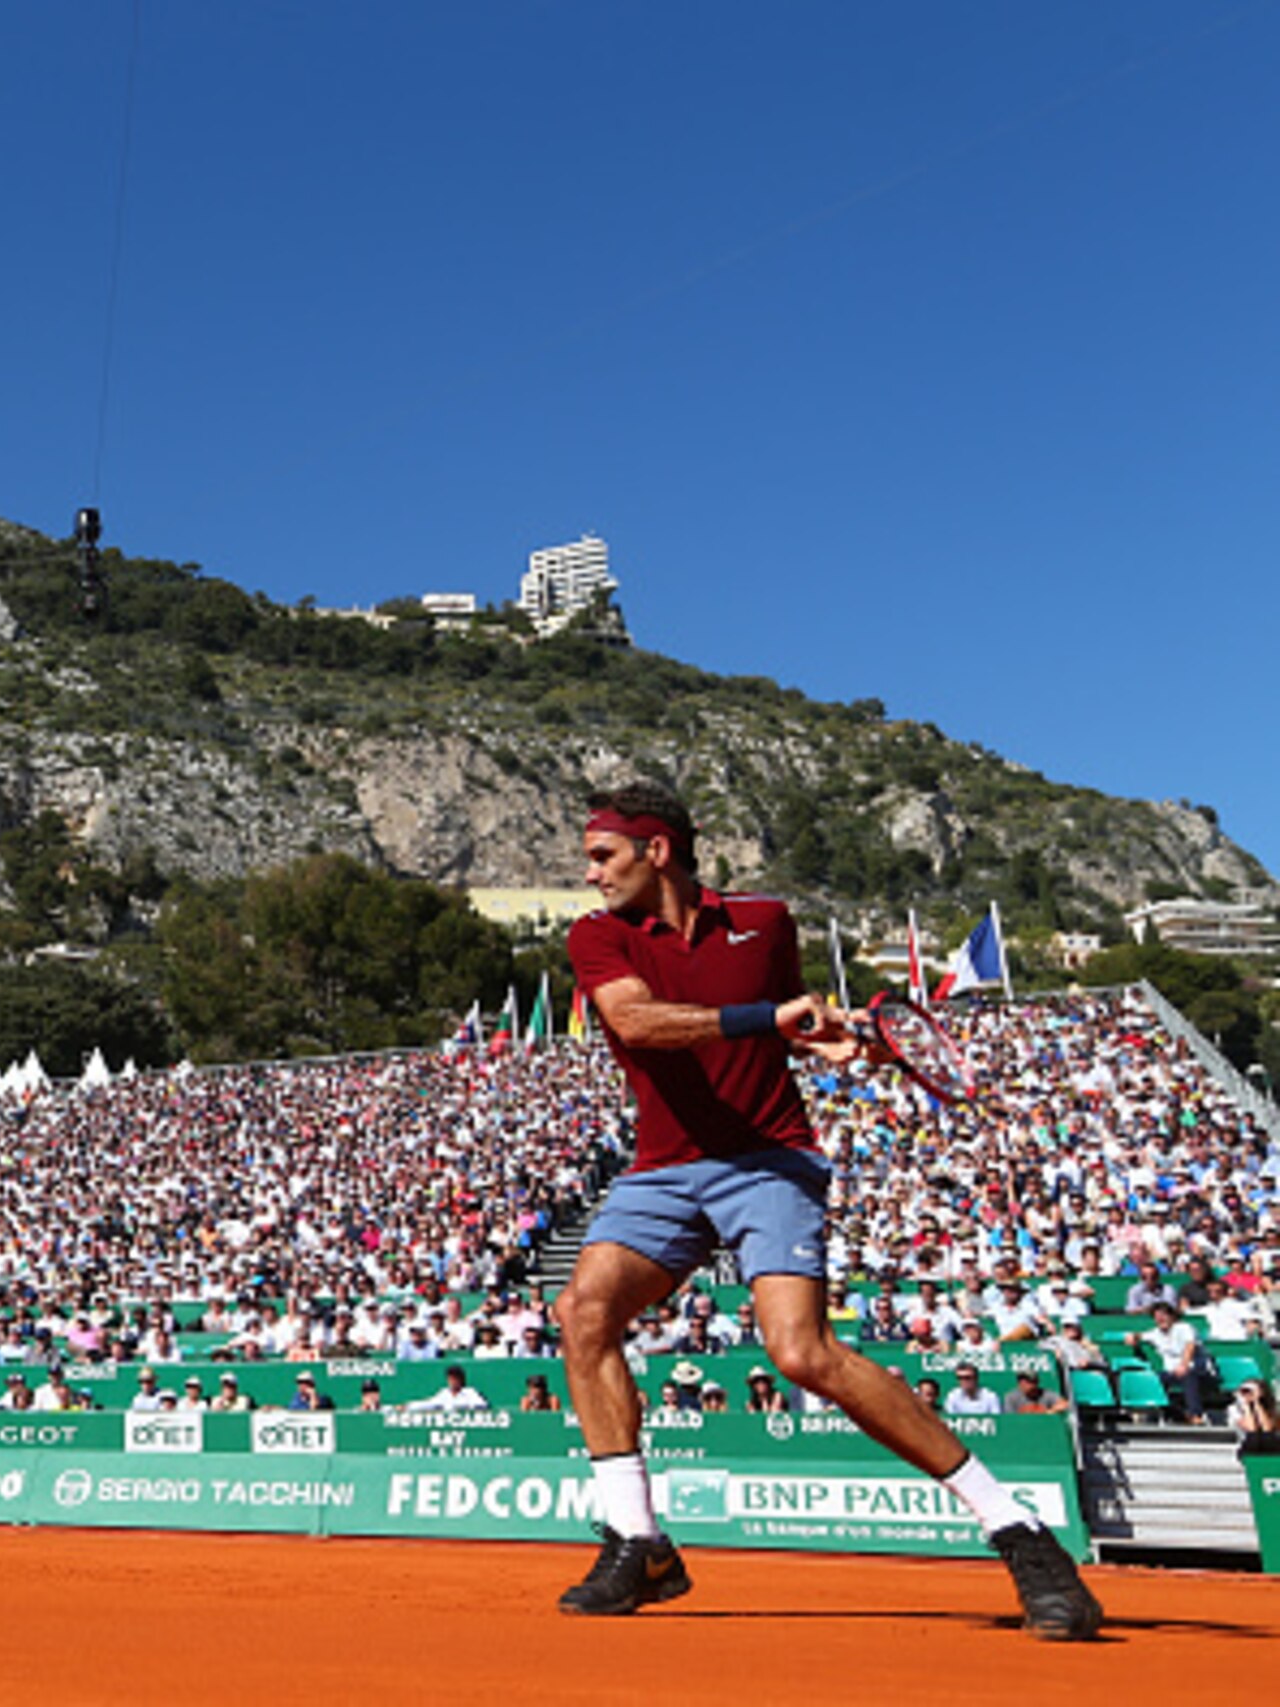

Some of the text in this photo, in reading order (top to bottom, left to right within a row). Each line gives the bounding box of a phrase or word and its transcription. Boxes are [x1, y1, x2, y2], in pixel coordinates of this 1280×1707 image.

[97, 1477, 355, 1506] SERGIO TACCHINI
[386, 1472, 610, 1522] FEDCOM
[742, 1482, 829, 1511] BNP
